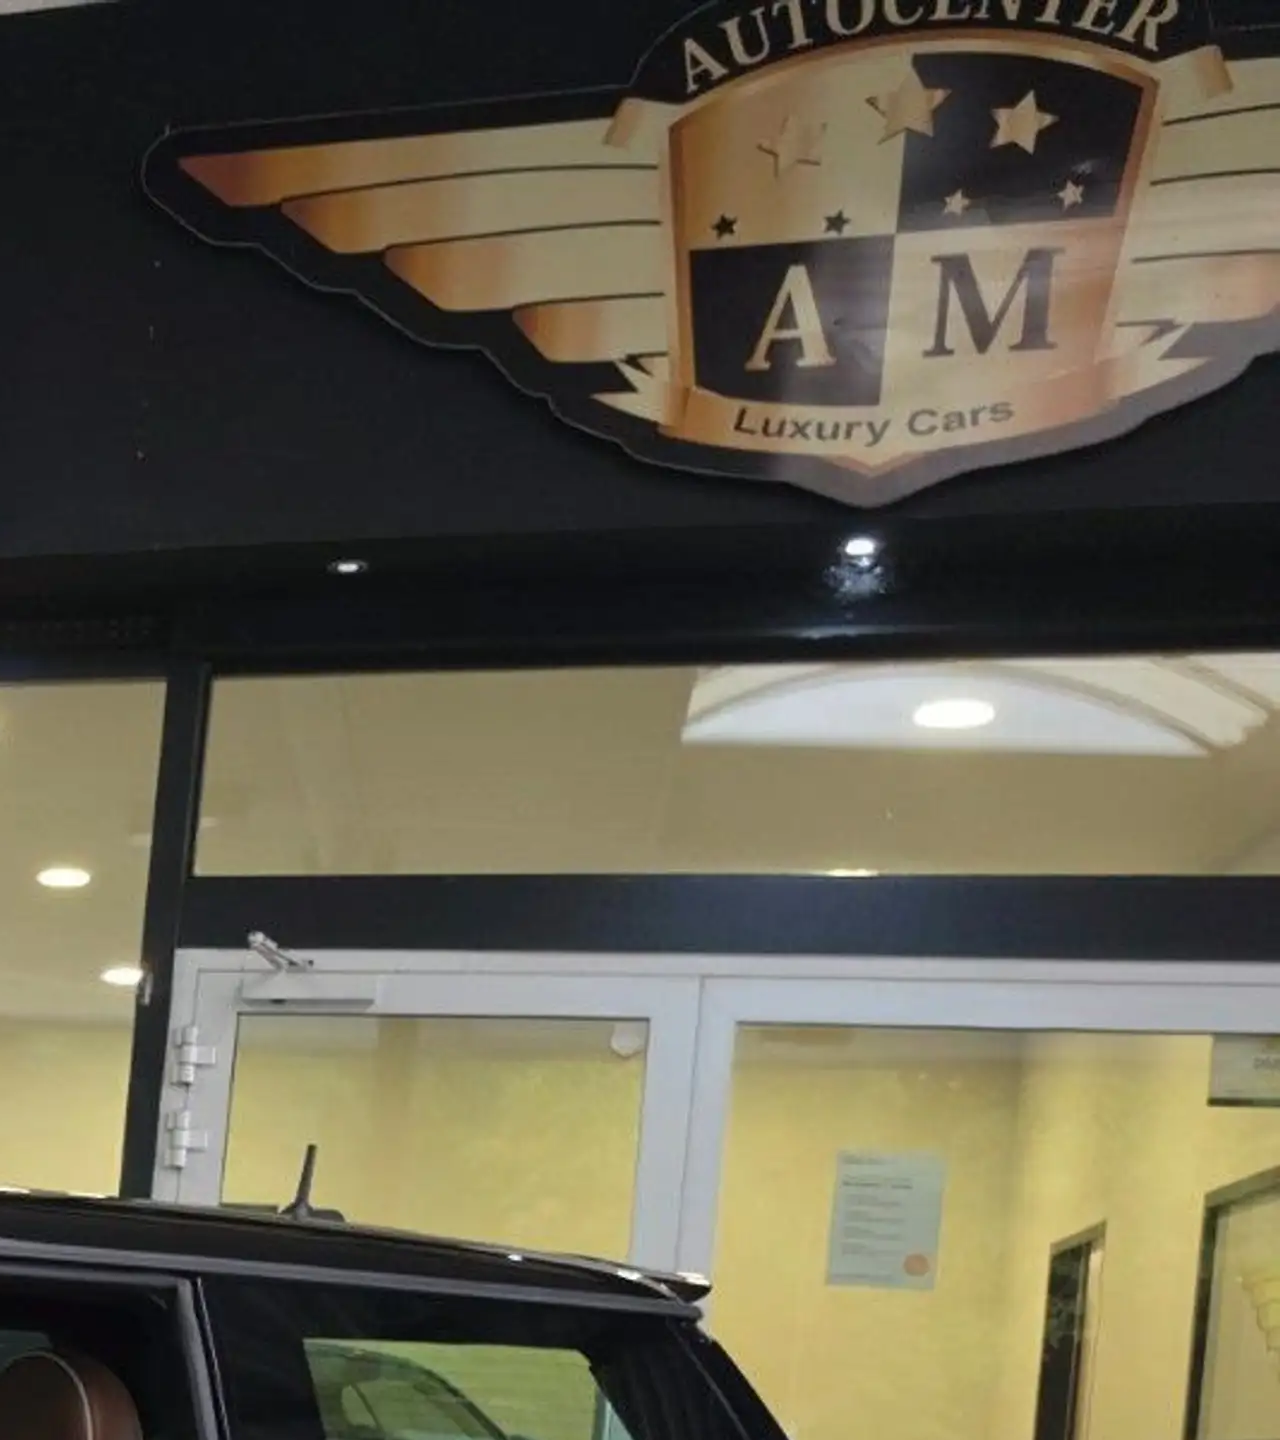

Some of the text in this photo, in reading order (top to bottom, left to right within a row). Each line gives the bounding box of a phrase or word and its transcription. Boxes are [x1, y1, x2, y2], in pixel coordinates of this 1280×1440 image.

[744, 246, 1064, 371] A M
[733, 401, 1016, 447] Luxury Cars
